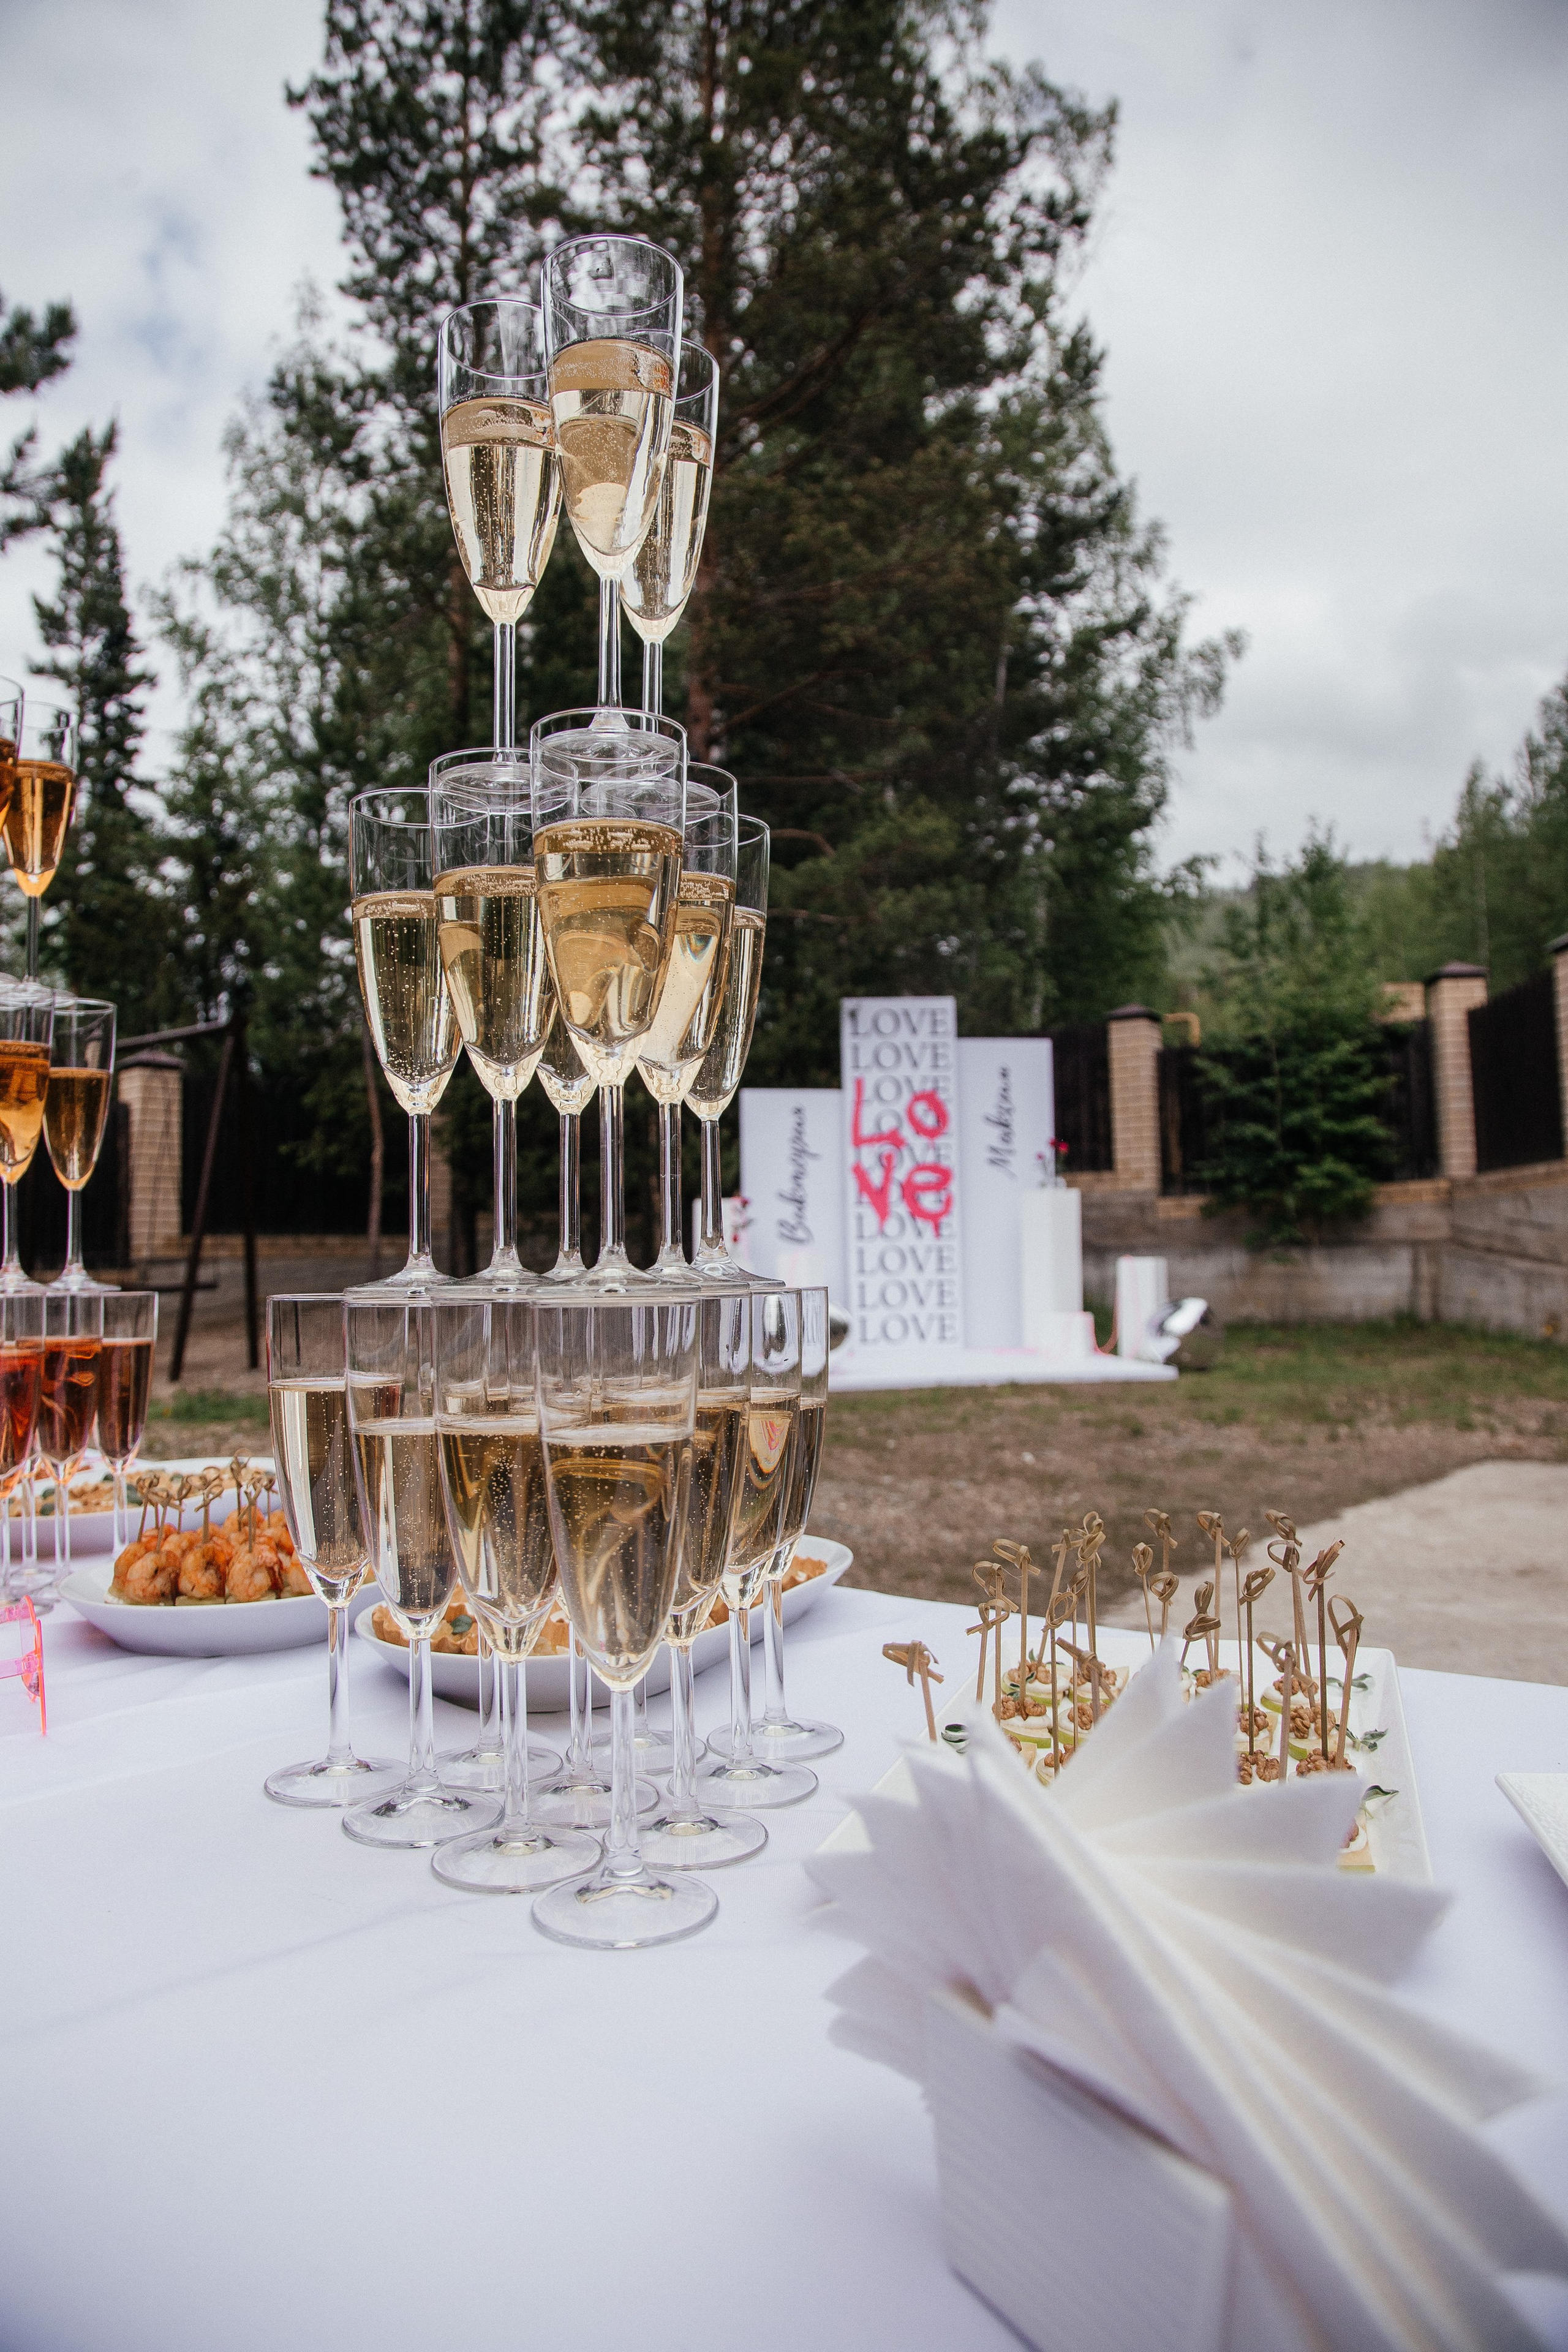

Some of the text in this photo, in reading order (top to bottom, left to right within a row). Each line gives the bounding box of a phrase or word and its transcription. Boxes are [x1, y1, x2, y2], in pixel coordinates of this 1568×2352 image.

[849, 1008, 950, 1035] LOVE
[851, 1041, 951, 1069] LOVE
[852, 1074, 951, 1102] OVE
[857, 1244, 957, 1275] LOVE
[858, 1278, 957, 1309] LOVE
[859, 1313, 958, 1343] LOVE
